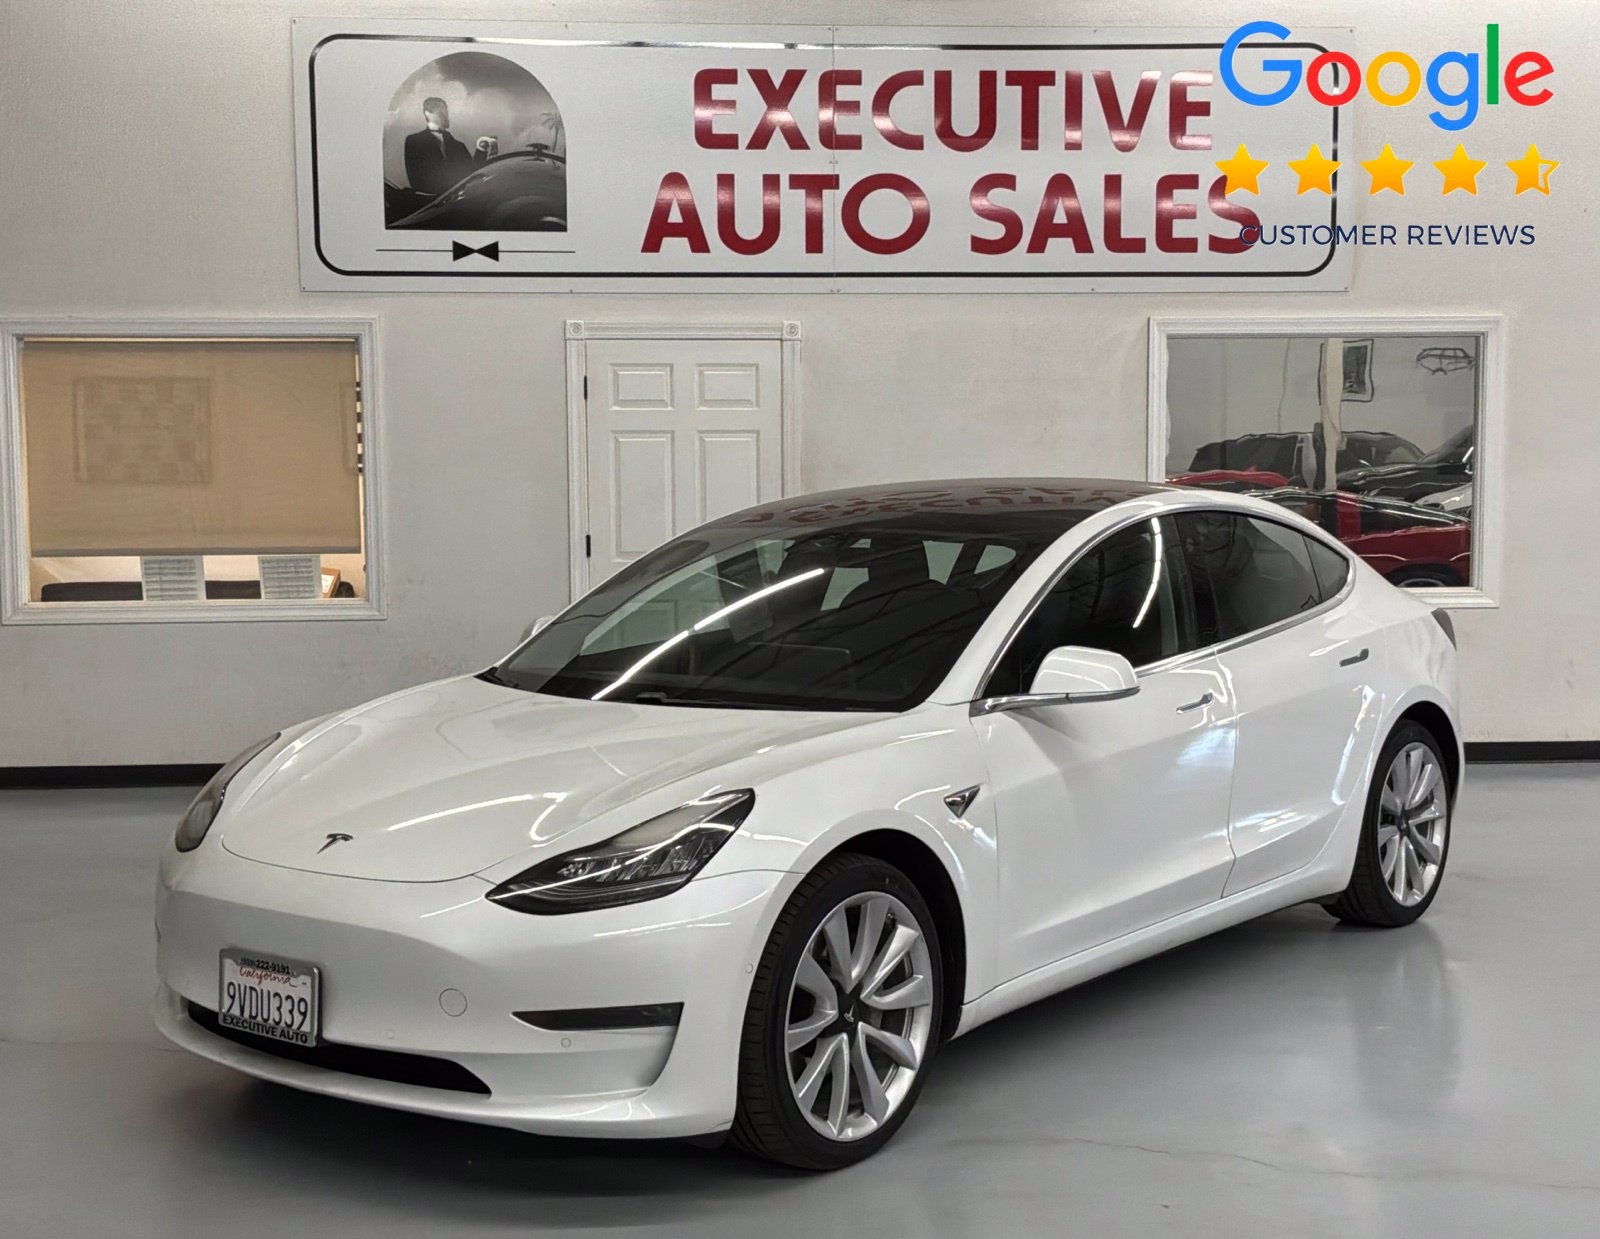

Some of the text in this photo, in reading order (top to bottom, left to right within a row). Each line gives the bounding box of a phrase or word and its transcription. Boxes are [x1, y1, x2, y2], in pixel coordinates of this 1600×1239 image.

[693, 68, 1214, 153] EXECUTIVE
[640, 171, 1261, 255] AUTO SALES
[223, 1014, 308, 1044] EXECUTIVE AUTO
[227, 981, 308, 1031] 9VDU339
